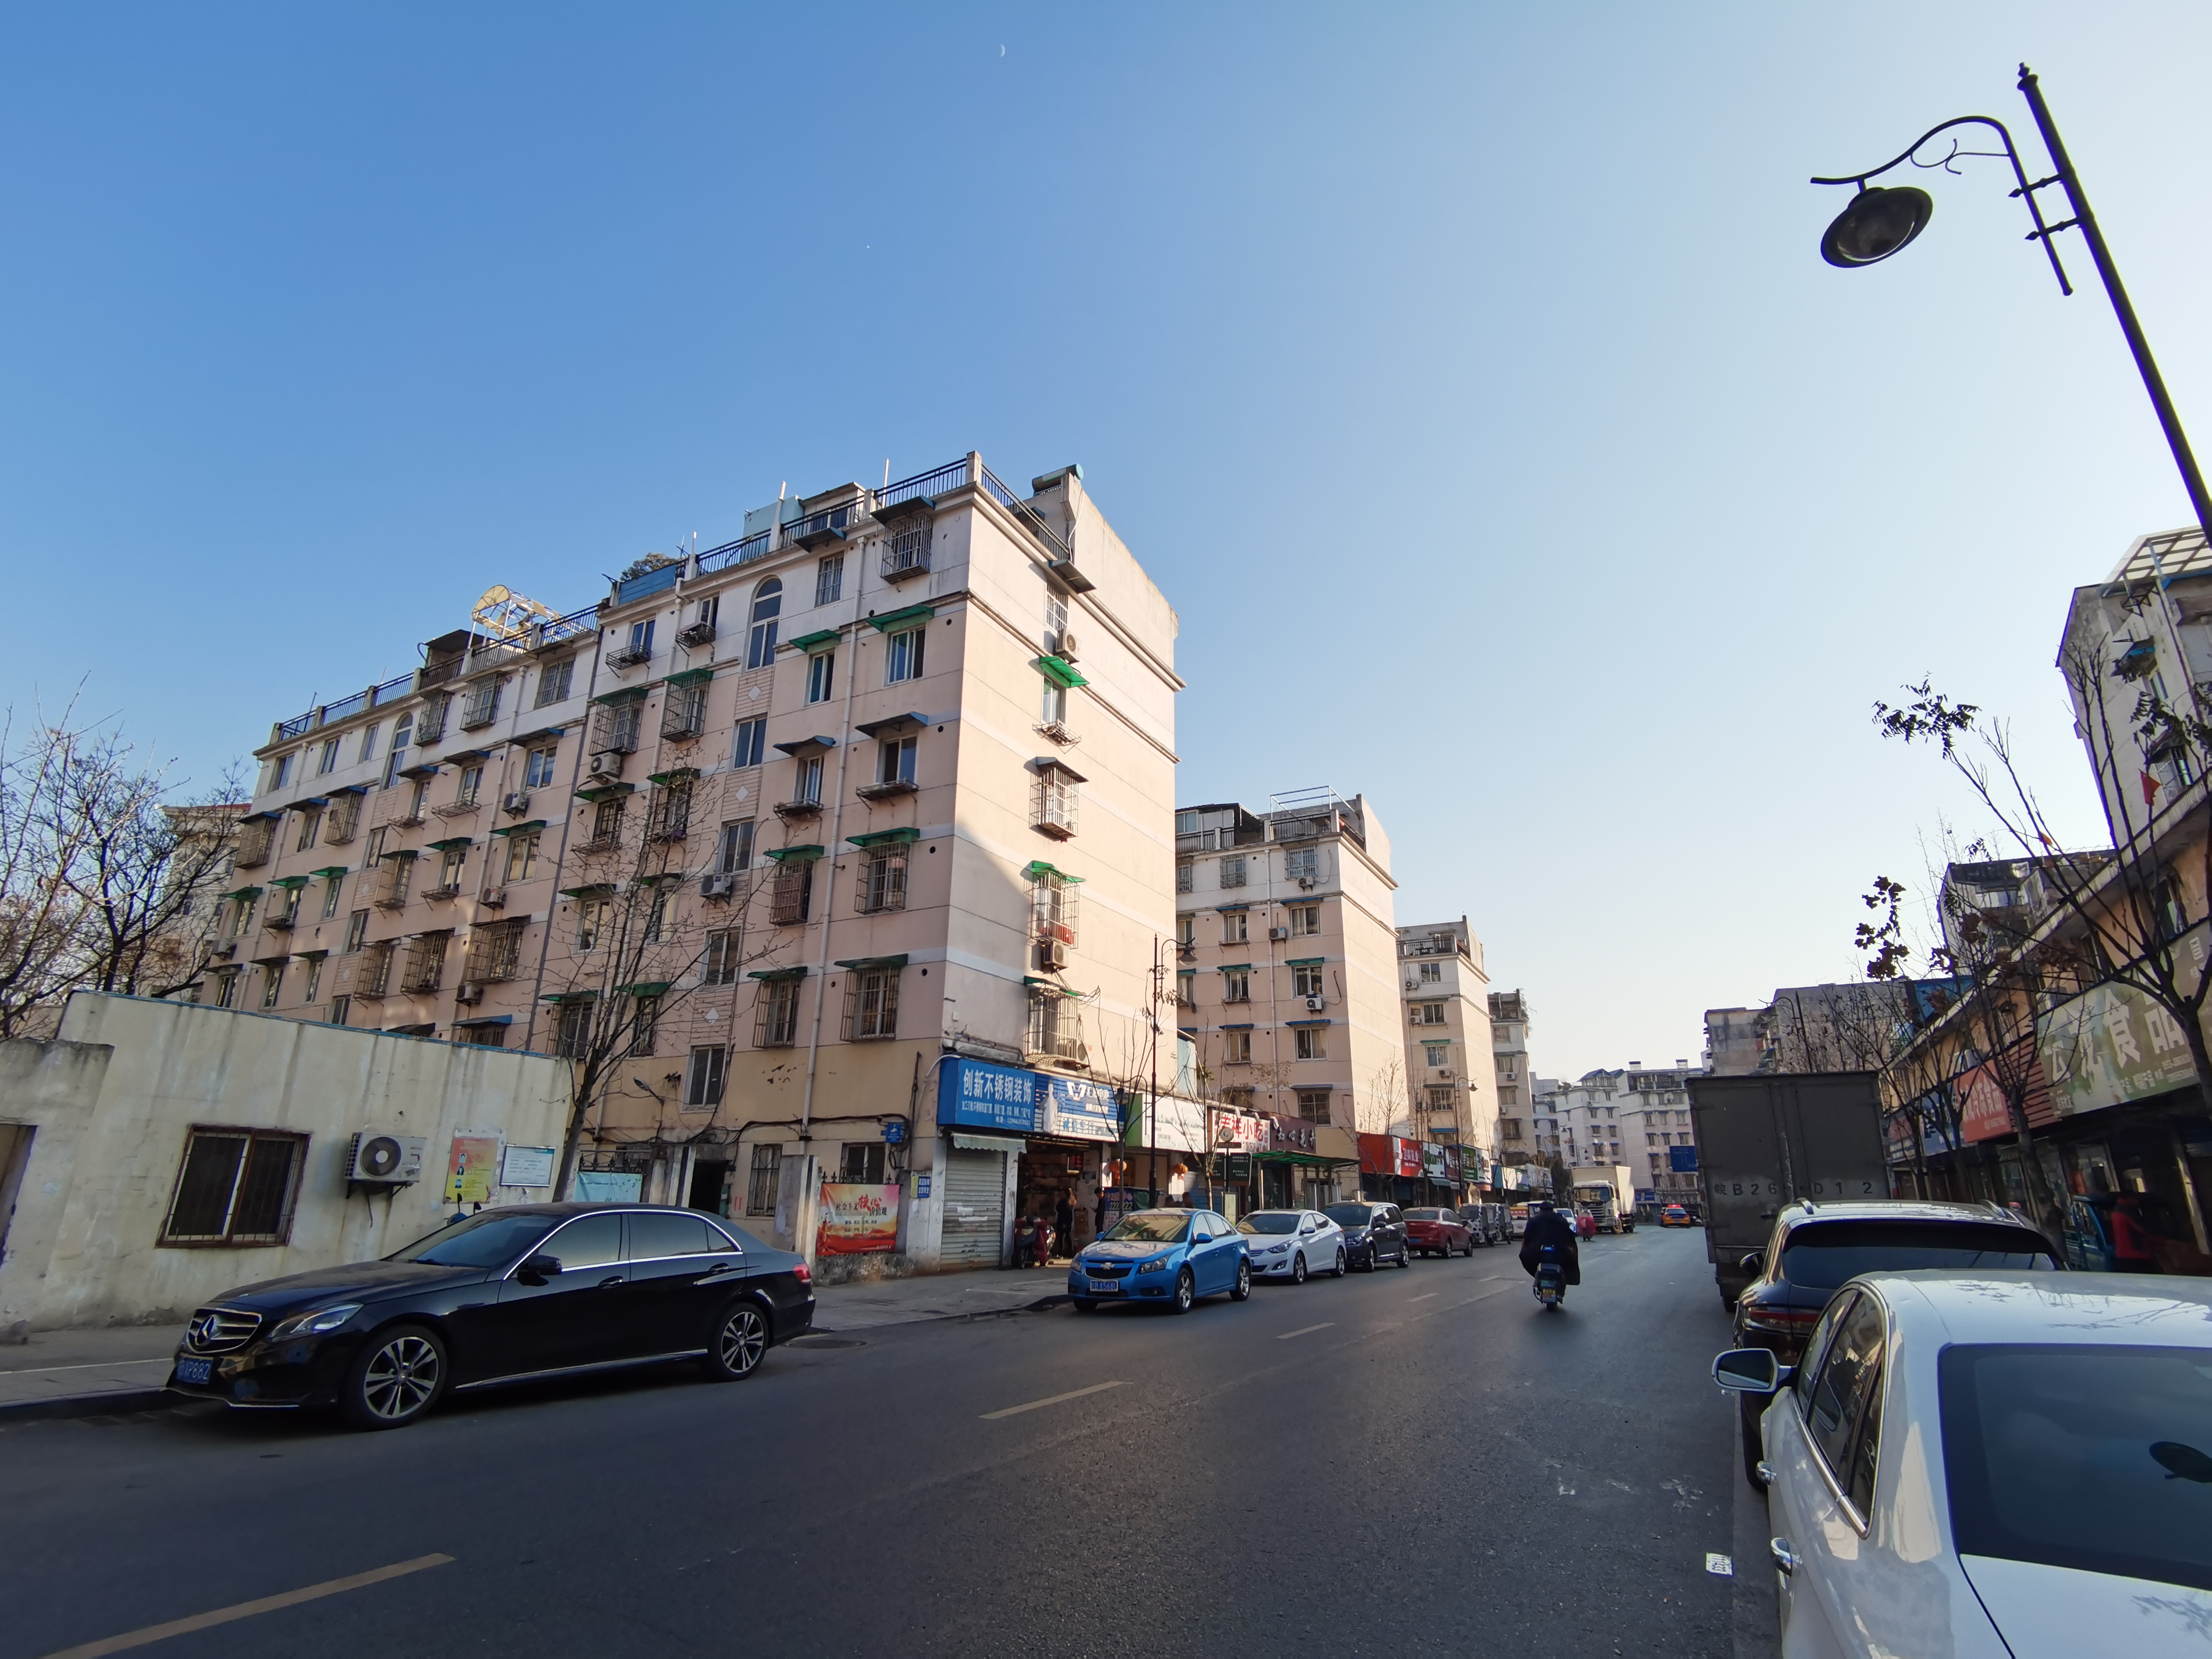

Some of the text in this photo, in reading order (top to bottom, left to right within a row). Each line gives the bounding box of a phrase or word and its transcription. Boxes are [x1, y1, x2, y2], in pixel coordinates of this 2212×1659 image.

[963, 1068, 1032, 1105] 创新不锈钢装饰
[836, 1193, 887, 1217] 社会主义 核心 价值观
